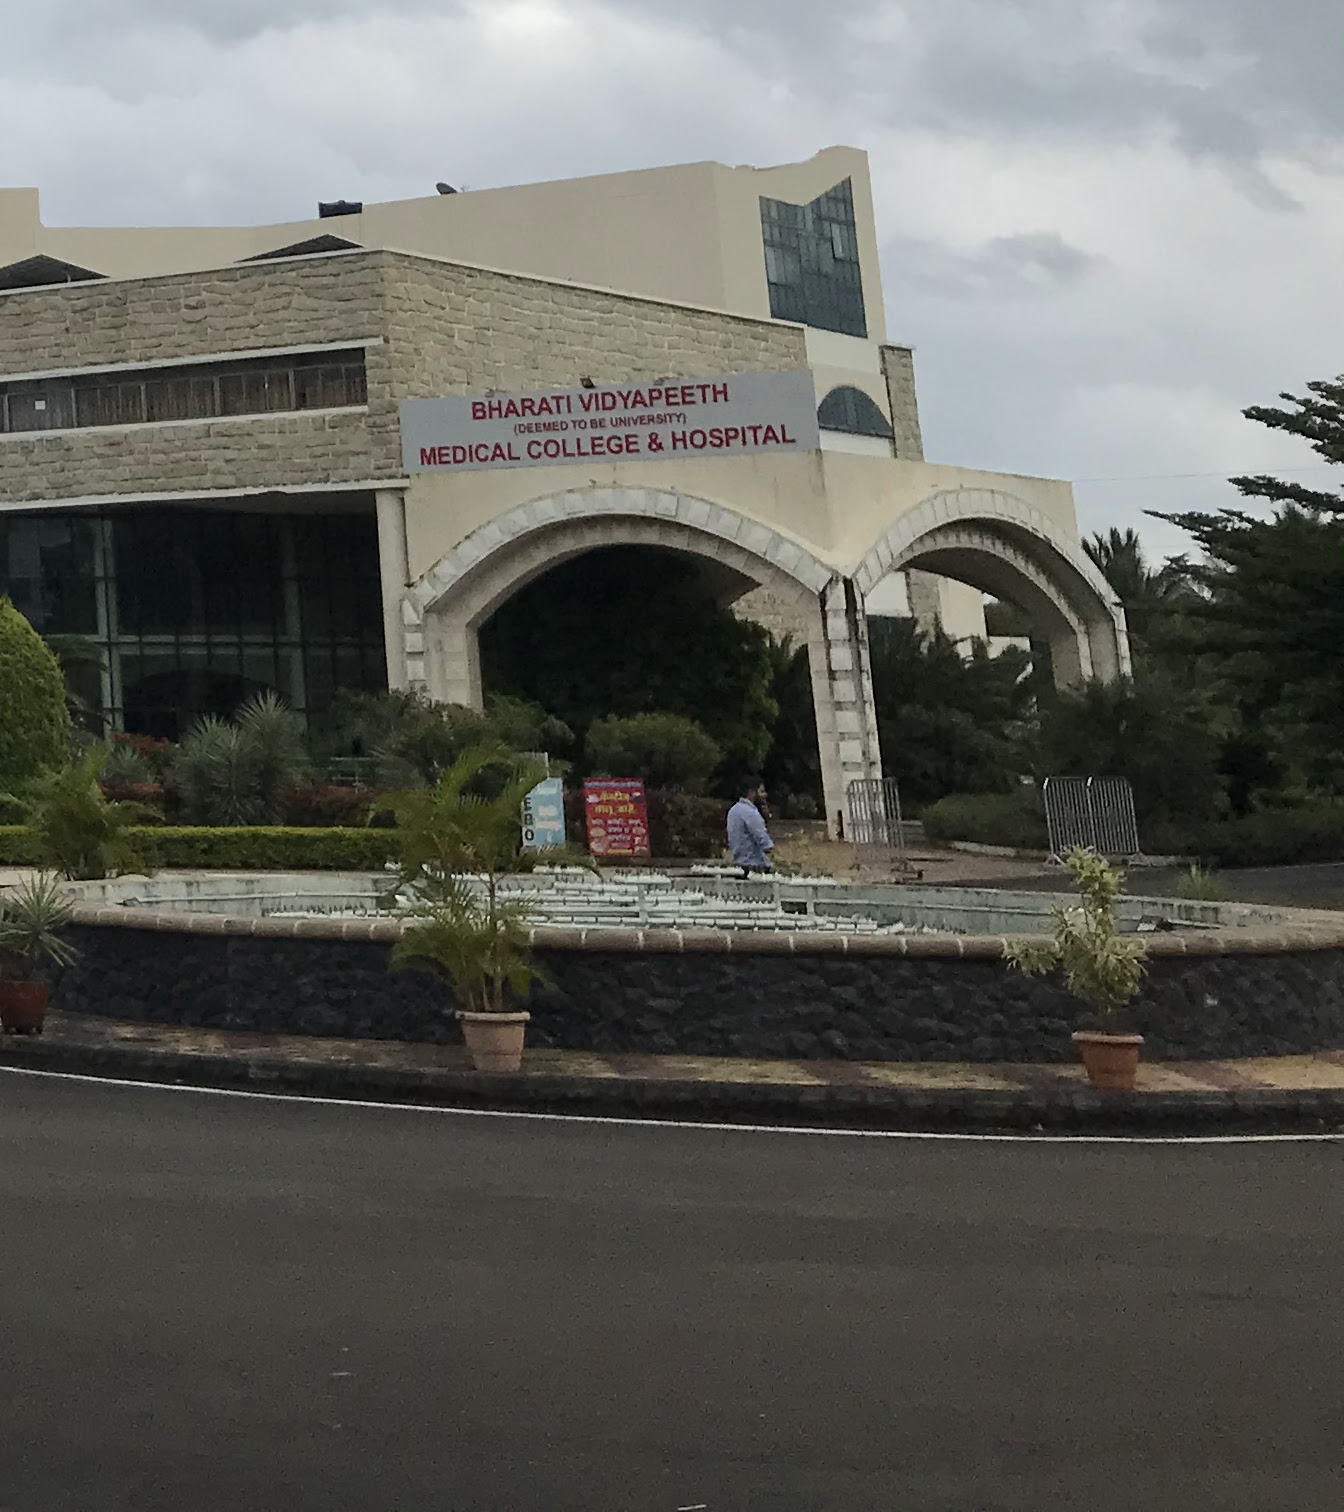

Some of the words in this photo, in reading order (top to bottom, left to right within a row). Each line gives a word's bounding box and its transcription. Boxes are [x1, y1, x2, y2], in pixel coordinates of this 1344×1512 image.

[472, 394, 572, 421] BHARATI
[579, 382, 729, 411] VIDYAPEETH
[514, 420, 569, 436] (DEEMED
[571, 419, 587, 430] TO
[590, 417, 607, 429] BE
[610, 412, 687, 428] UNIVERSITY)
[419, 444, 521, 466] MEDICAL
[526, 433, 640, 459] COLLEGE
[647, 434, 665, 452] &
[671, 423, 796, 451] HOSPITAL
